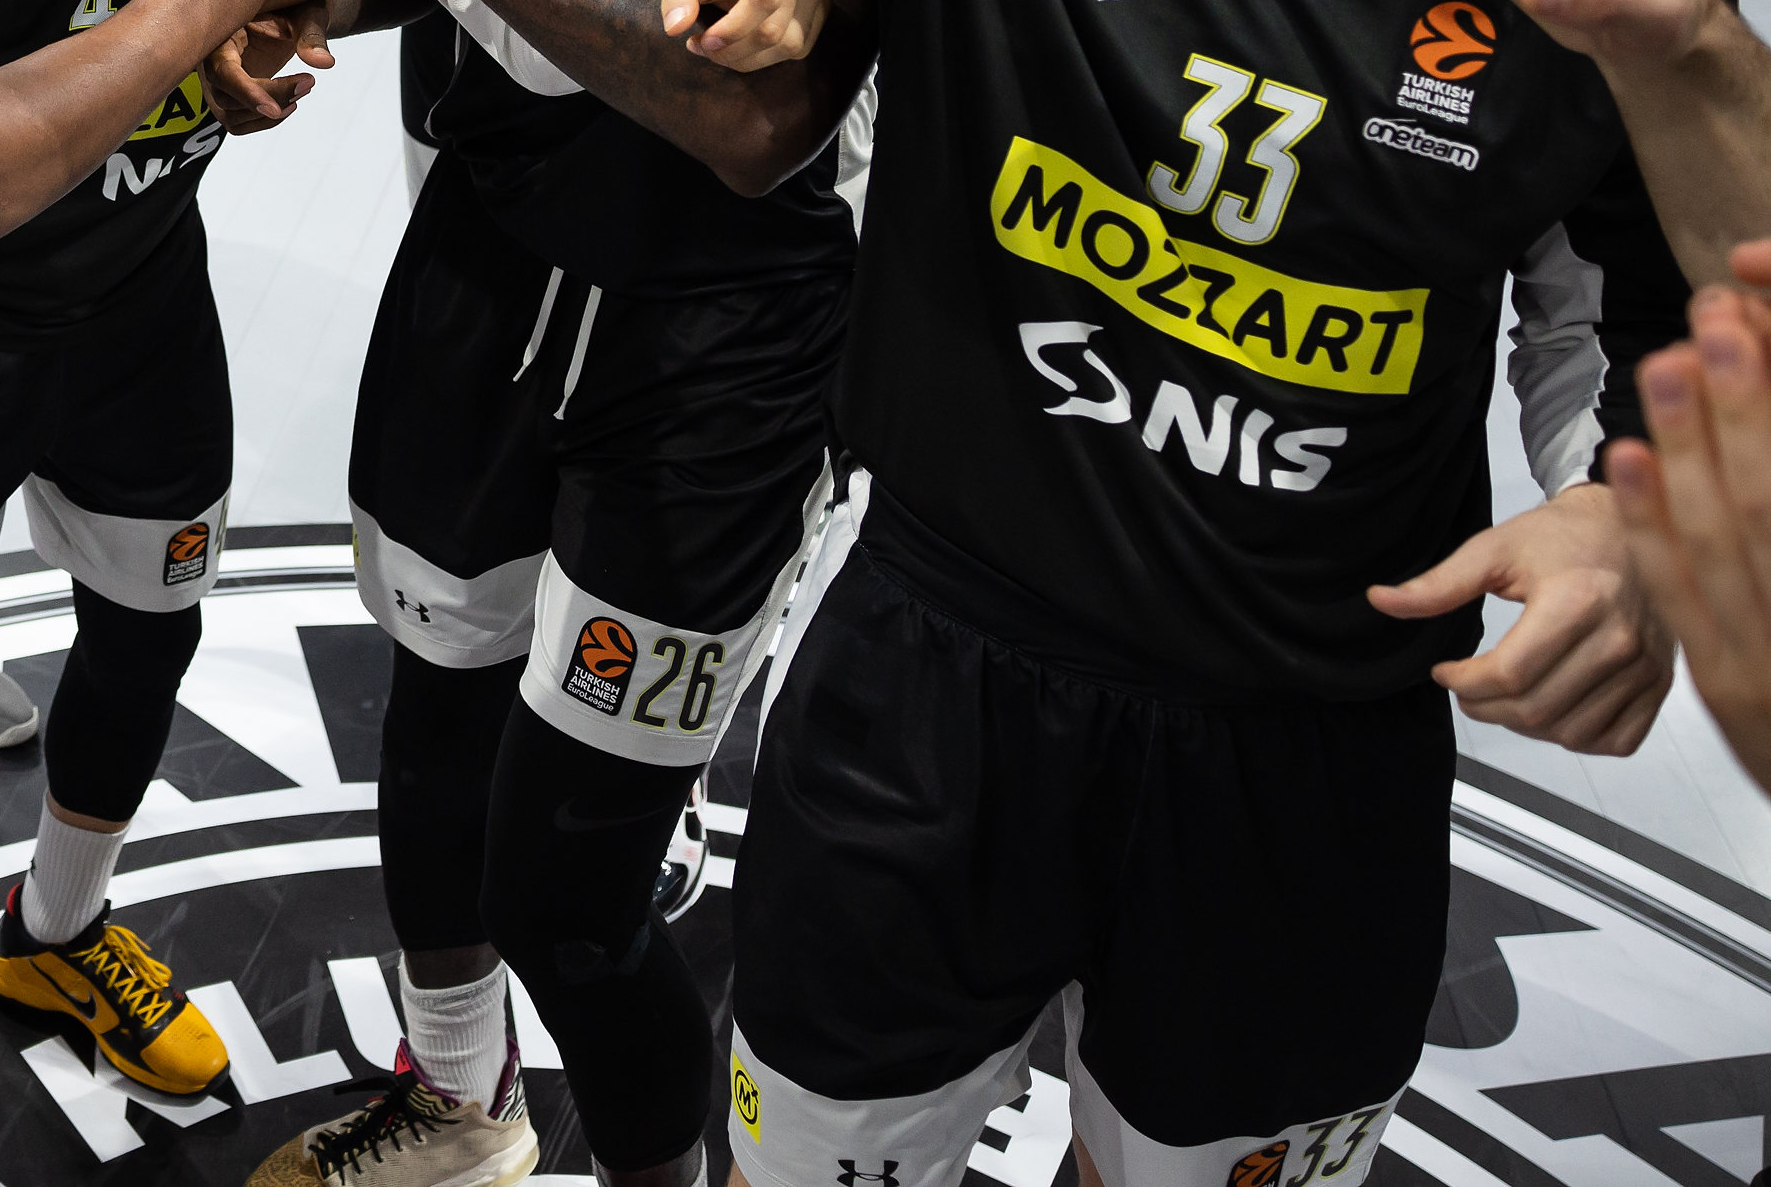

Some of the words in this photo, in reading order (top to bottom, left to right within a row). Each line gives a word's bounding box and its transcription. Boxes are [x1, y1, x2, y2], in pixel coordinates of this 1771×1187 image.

[1399, 86, 1470, 114] AIRLINES
[1402, 72, 1474, 102] TURKISH
[1396, 97, 1469, 125] EuroLeague
[1146, 52, 1328, 245] 33
[1364, 118, 1479, 171] oneteam
[1001, 164, 1414, 376] MOZZART
[1141, 380, 1348, 492] NIS
[168, 555, 205, 571] TURKISH
[570, 676, 618, 704] AIRLINES
[575, 665, 621, 695] TURKISH
[630, 634, 726, 733] 26
[566, 682, 614, 712] EuroLeague
[1286, 1105, 1389, 1187] 33
